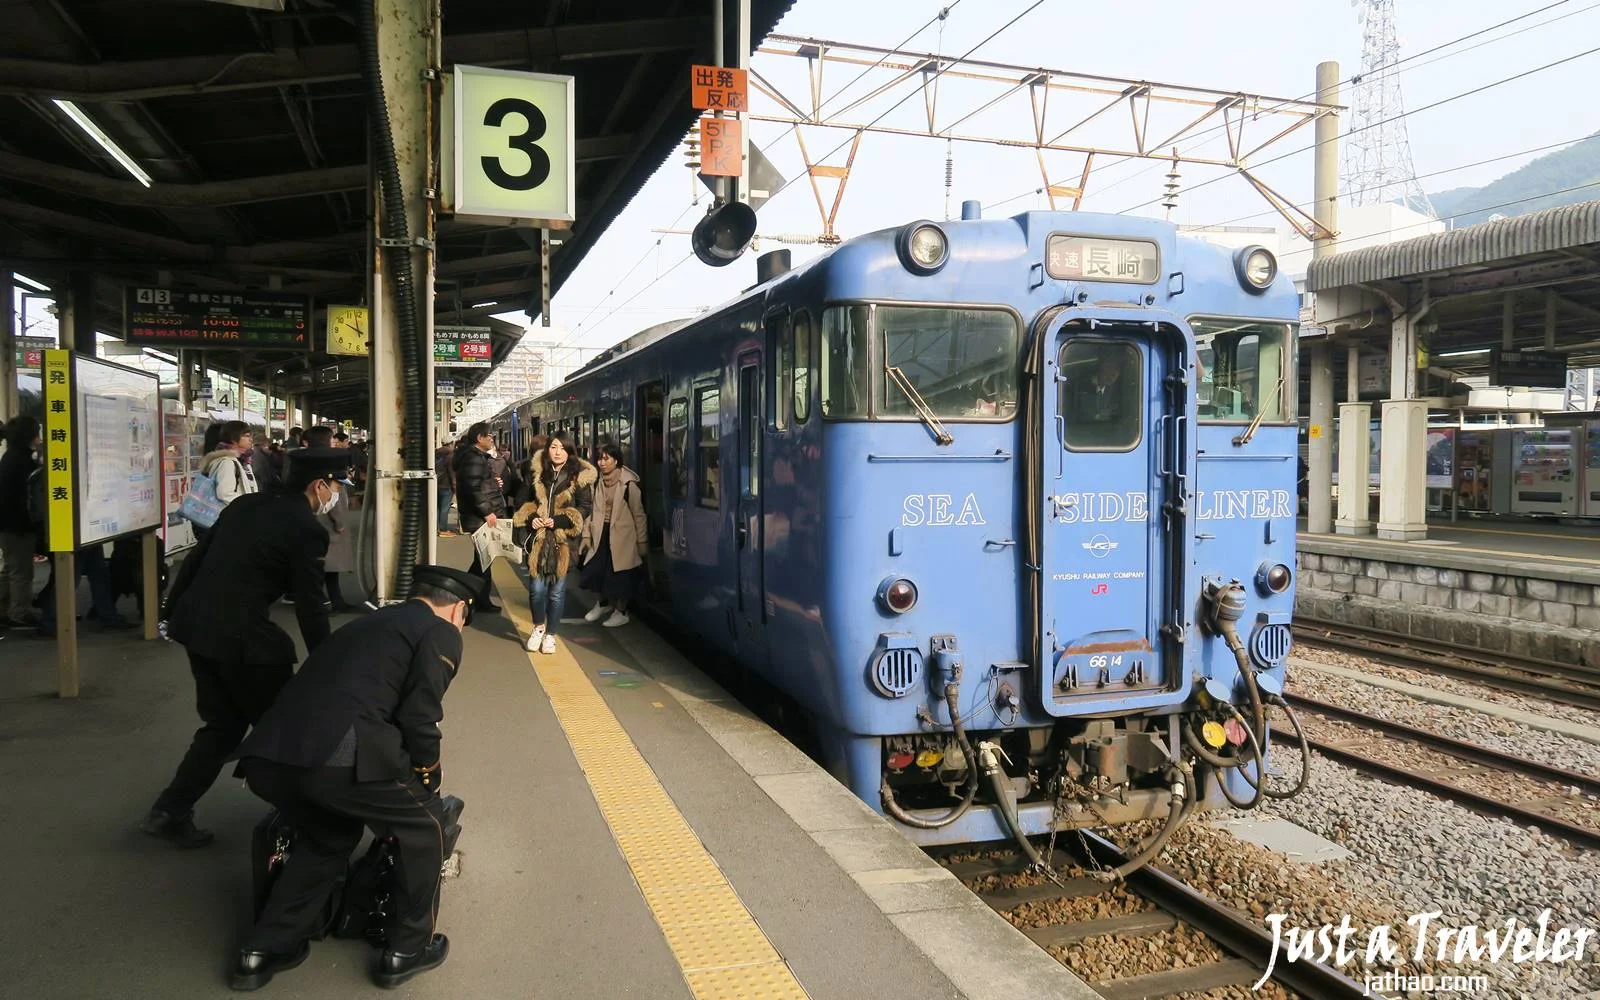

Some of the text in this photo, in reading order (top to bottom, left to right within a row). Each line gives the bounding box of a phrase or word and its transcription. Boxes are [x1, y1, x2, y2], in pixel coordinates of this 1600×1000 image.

[696, 68, 733, 88] 出発
[707, 89, 743, 107] 反応
[706, 121, 736, 138] 5L
[481, 98, 551, 191] 3
[1087, 246, 1141, 278] 長崎
[336, 316, 344, 324] 10
[346, 311, 352, 319] 11
[463, 344, 488, 354] 2号車
[218, 394, 230, 407] 4
[454, 400, 464, 414] 3
[49, 370, 68, 501] 発車時刻表
[902, 489, 1292, 527] SEA SIDE LINER
[1053, 571, 1145, 581] KYUSHU RAILWAY COMPANY
[1091, 583, 1109, 595] JR
[1089, 655, 1107, 668] 66
